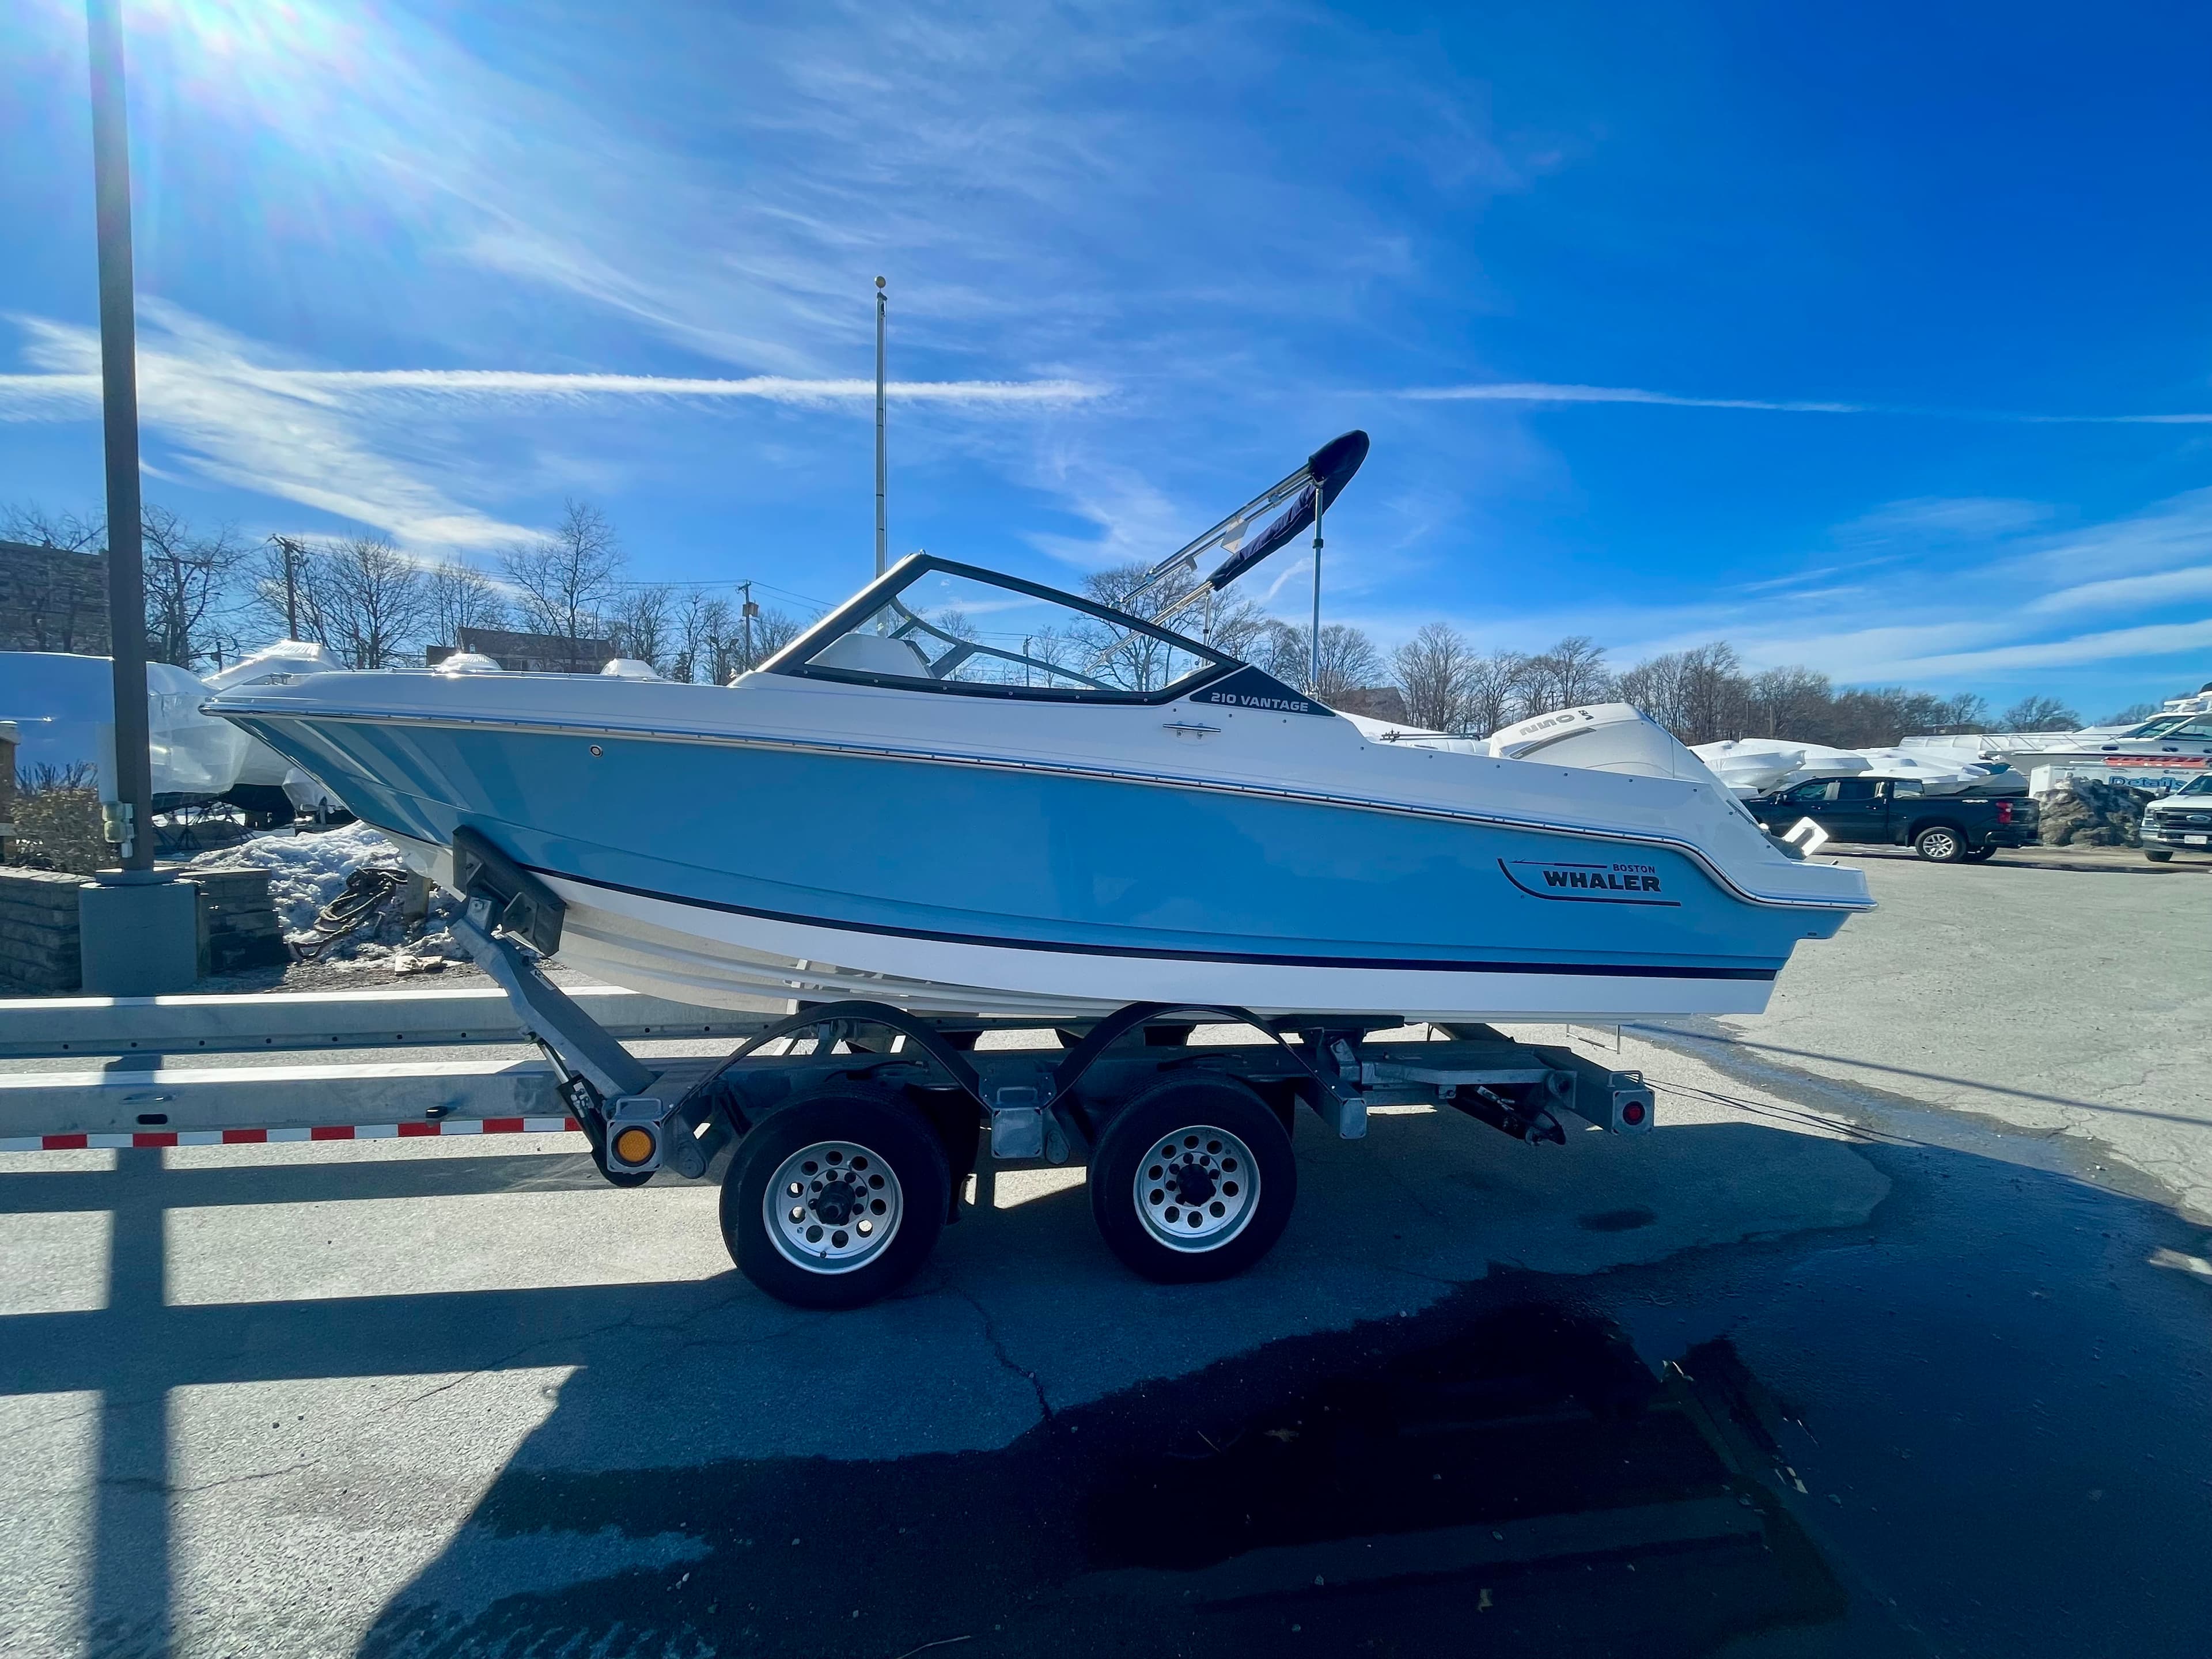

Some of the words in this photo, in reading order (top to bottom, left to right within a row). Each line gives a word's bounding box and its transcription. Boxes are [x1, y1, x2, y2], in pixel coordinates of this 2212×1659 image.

[1211, 692, 1236, 704] 210
[1241, 695, 1309, 711] VANTAGE
[1520, 714, 1575, 736] 250
[1613, 864, 1655, 873] BOSTON
[1543, 870, 1662, 892] WHALER
